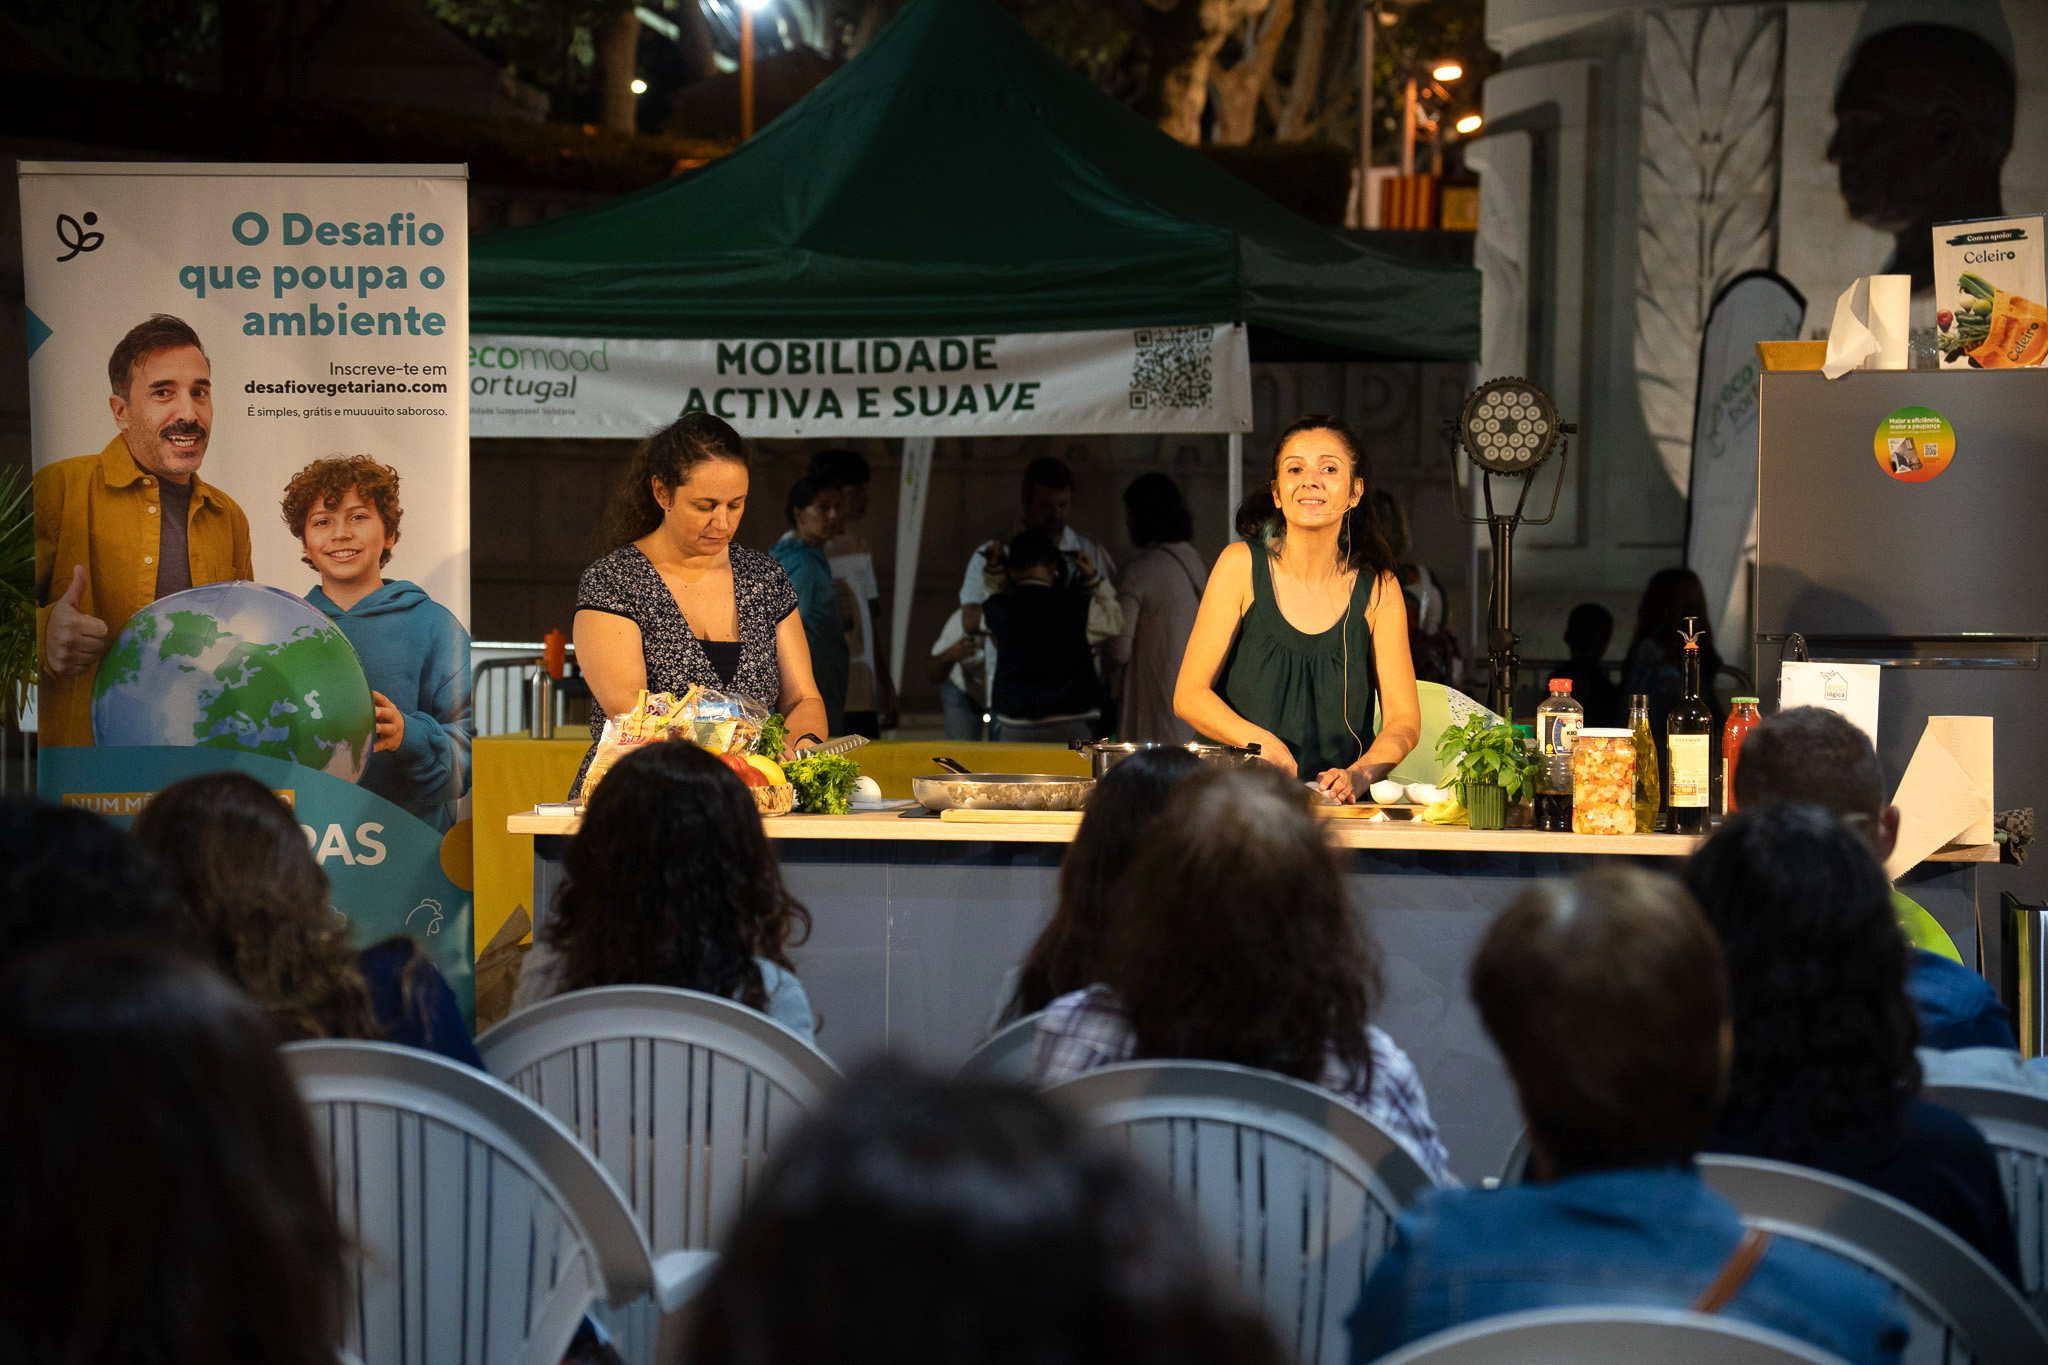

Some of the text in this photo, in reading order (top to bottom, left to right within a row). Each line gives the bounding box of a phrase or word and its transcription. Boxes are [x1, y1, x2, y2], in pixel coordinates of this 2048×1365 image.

[232, 211, 445, 246] O Desafio
[1967, 234, 1984, 242] Com
[1964, 249, 2016, 264] Celeiro
[178, 265, 446, 298] que poupa o
[242, 302, 446, 336] ambiente
[2008, 322, 2039, 362] Celeiro
[716, 337, 998, 375] MOBILIDADE
[329, 362, 447, 375] Inscreve-te em
[244, 380, 447, 397] desafiovegetariano.com
[470, 375, 577, 403] ortugal
[247, 404, 255, 416] É
[257, 406, 301, 419] simples,
[302, 406, 333, 418] grátis
[343, 406, 394, 416] muuuuito
[396, 406, 448, 416] saboroso.
[678, 382, 1041, 419] ACTIVA E SUAVE
[1826, 691, 1845, 699] lógica
[71, 798, 119, 813] NUM
